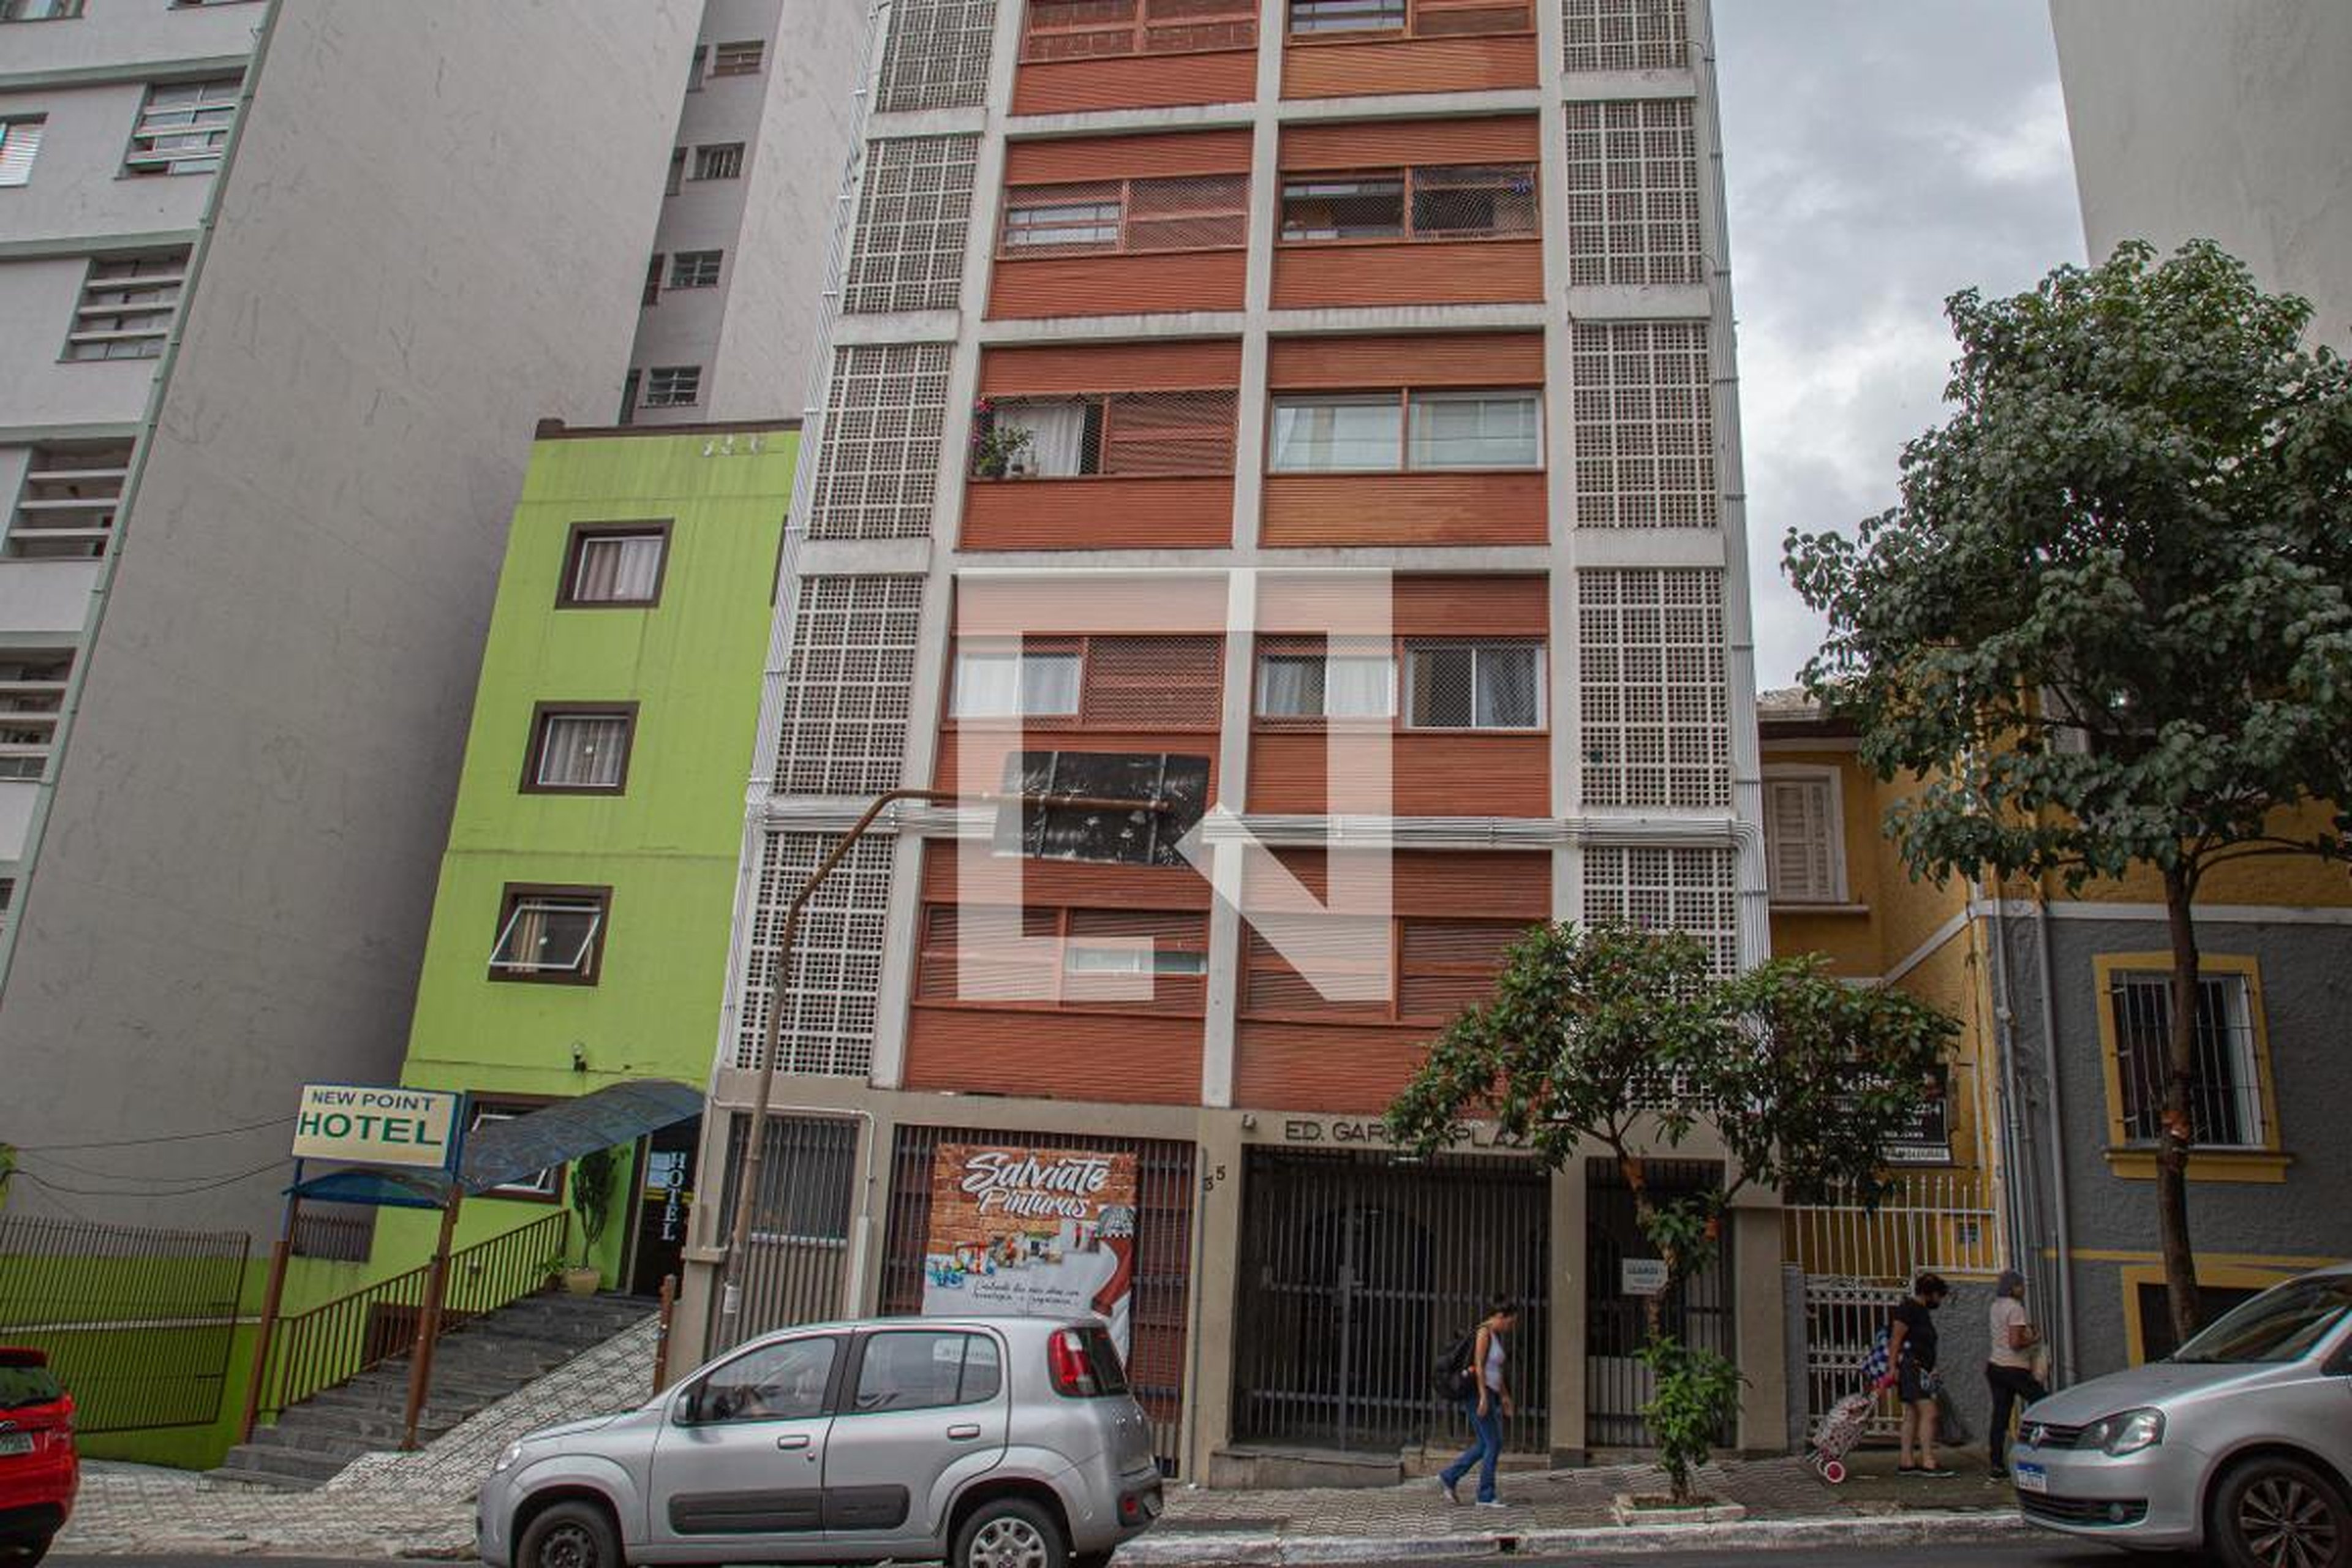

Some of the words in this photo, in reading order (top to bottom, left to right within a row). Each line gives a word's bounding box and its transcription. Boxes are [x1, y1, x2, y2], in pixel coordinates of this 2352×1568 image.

[312, 1091, 355, 1106] NEW
[363, 1093, 436, 1111] POINT
[298, 1111, 442, 1145] HOTEL
[1286, 1120, 1324, 1141] ED.
[661, 1152, 687, 1241] HOTEL
